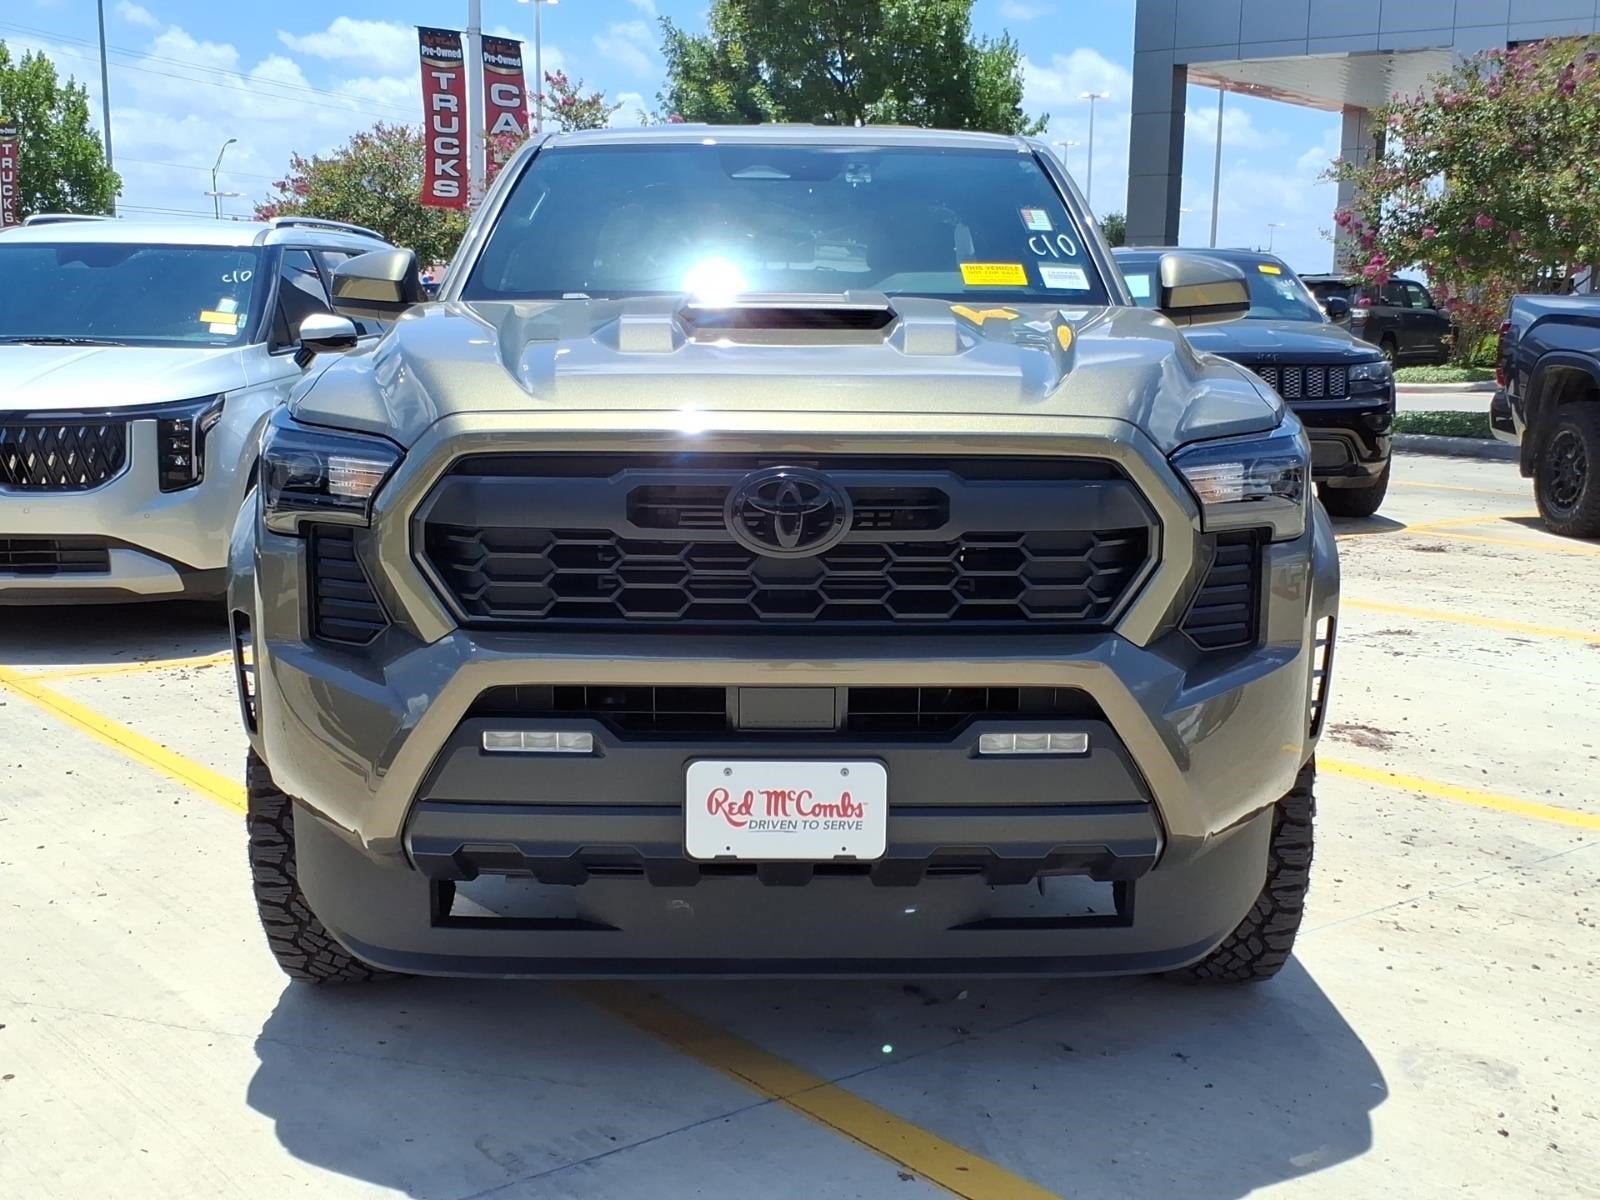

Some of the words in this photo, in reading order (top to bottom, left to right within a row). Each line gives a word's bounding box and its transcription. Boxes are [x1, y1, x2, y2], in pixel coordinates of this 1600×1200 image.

[421, 45, 462, 59] Pre-Owned
[483, 51, 521, 66] Pre-Owned
[431, 71, 461, 198] TRUCKS
[2, 143, 14, 223] TRUCKS
[706, 788, 755, 827] Red
[758, 790, 864, 818] McCombs
[749, 820, 797, 830] DRIVEN
[802, 820, 819, 830] TO
[823, 820, 863, 831] SERVE
